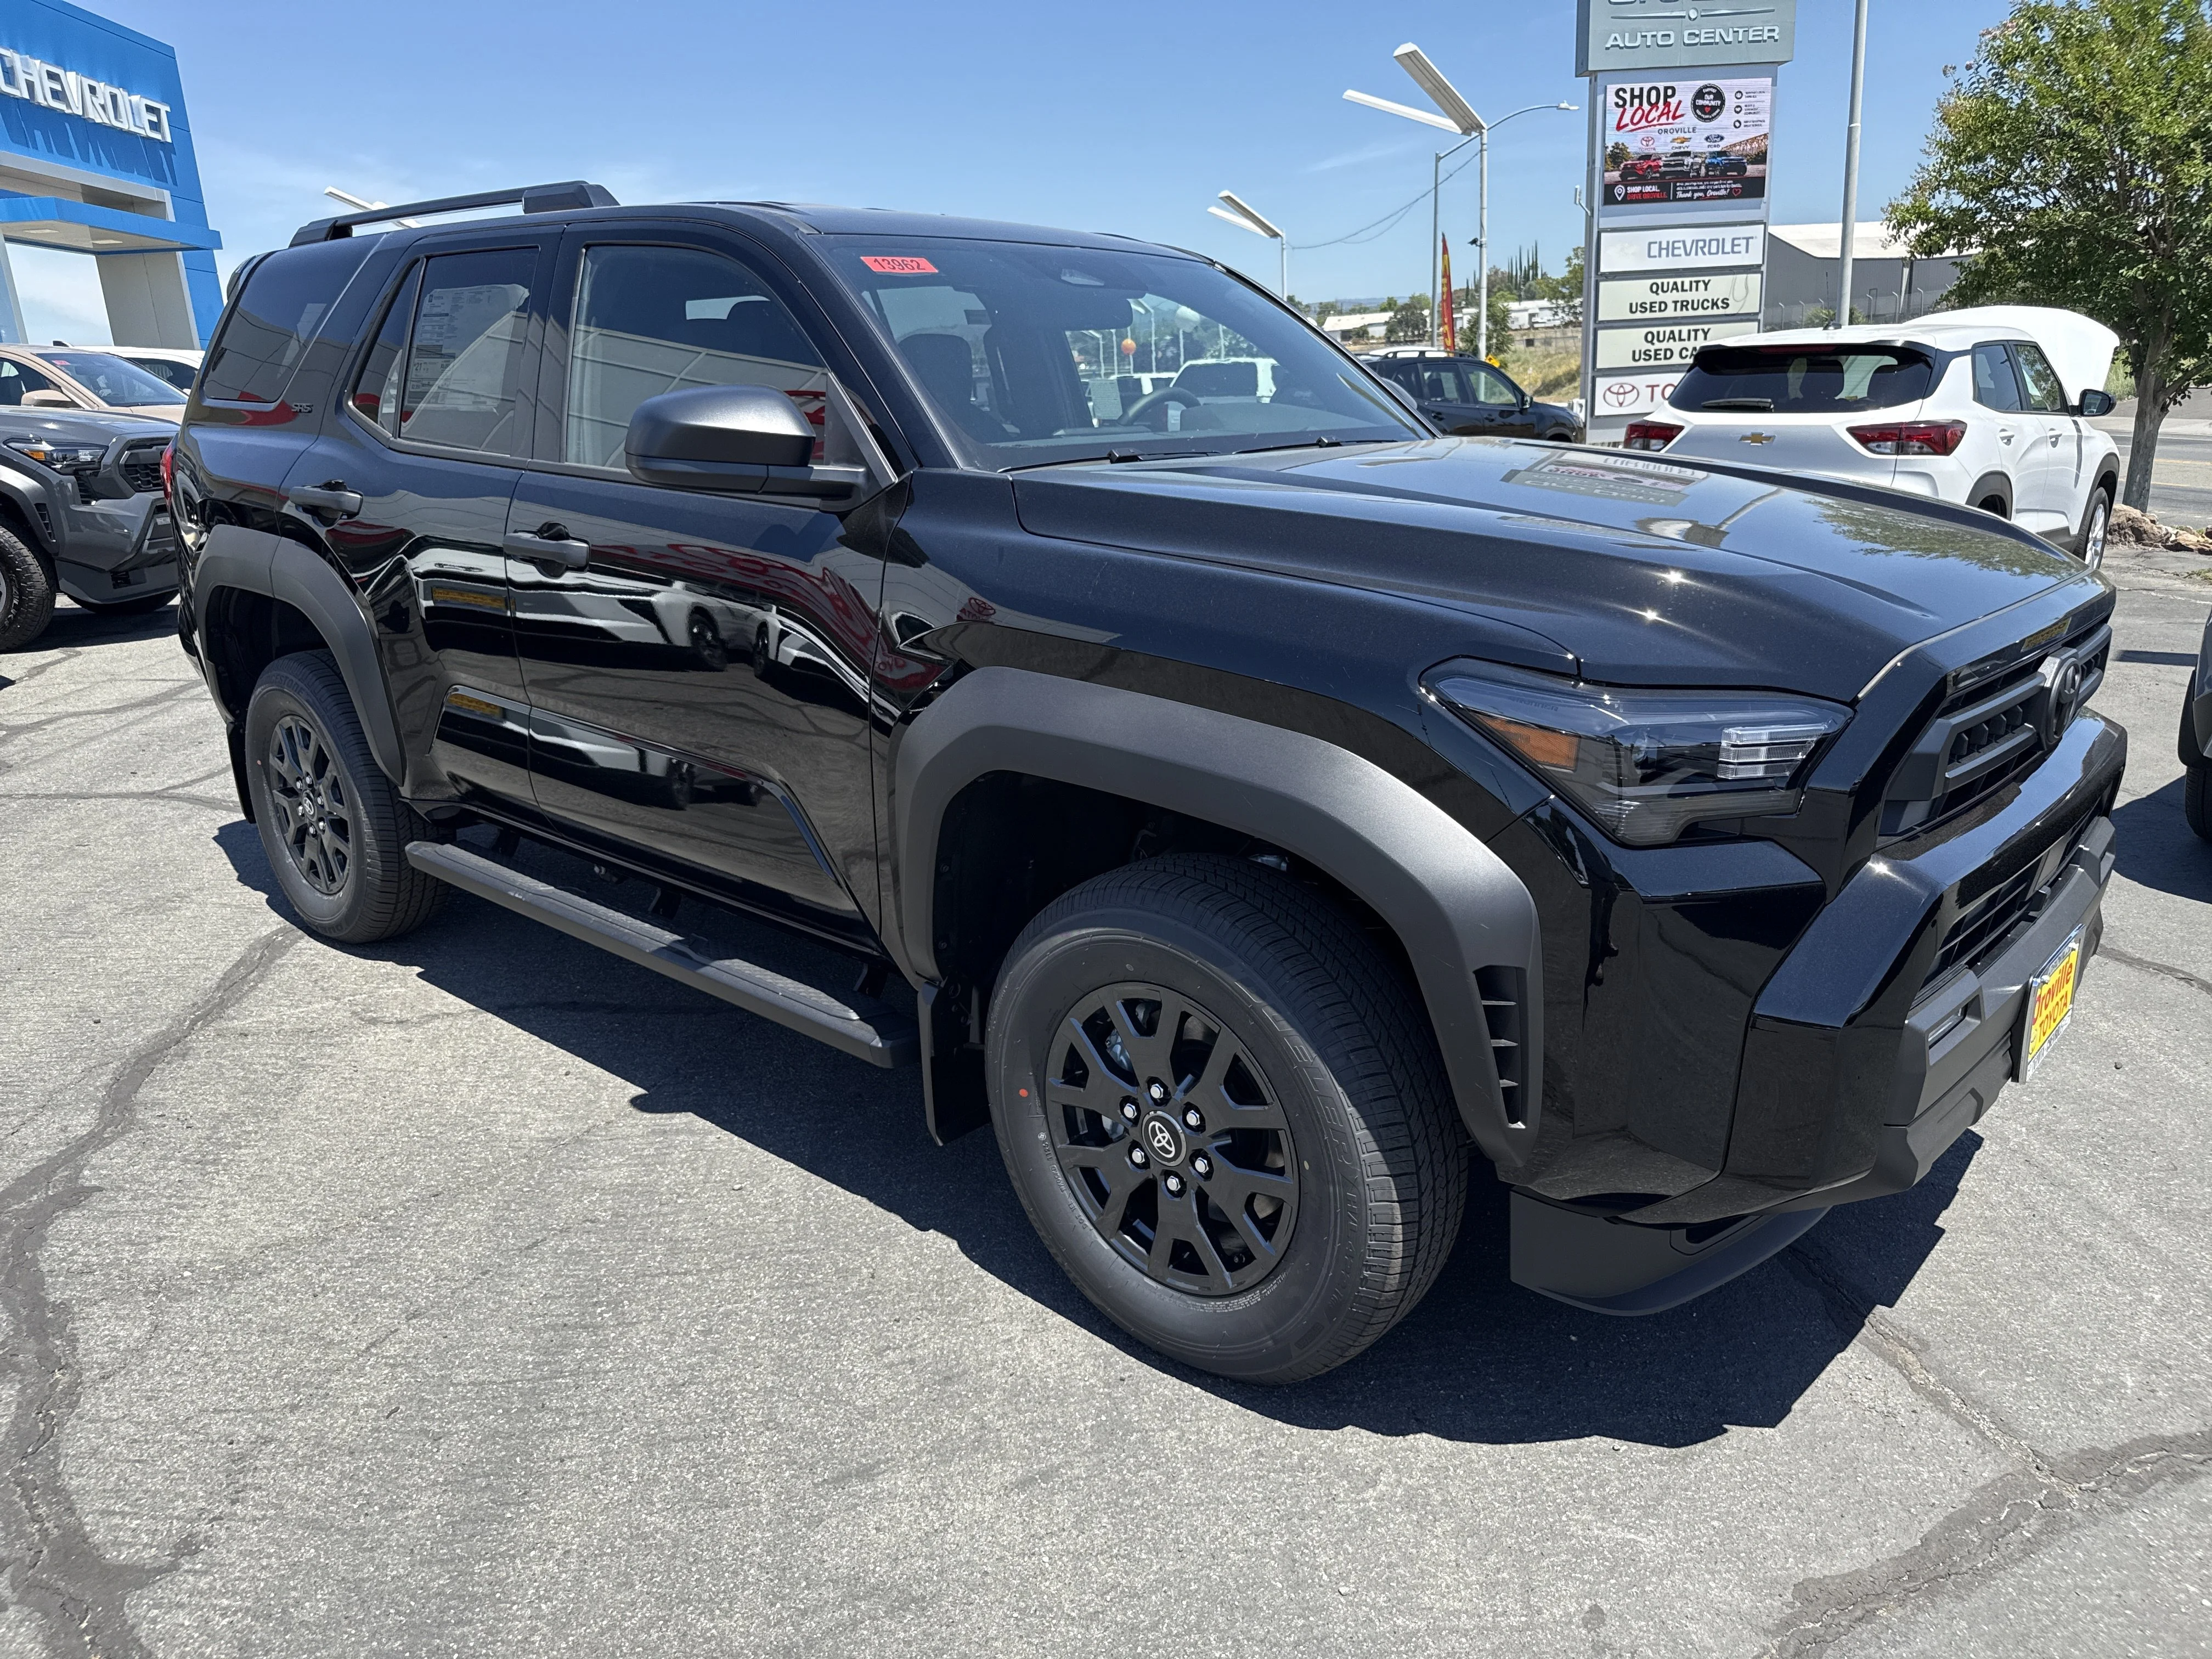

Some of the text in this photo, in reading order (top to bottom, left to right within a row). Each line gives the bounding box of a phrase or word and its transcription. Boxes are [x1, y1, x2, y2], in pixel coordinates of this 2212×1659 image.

[1605, 26, 1779, 49] AUTO CENTER
[0, 48, 172, 143] CHEVROLET
[1614, 86, 1676, 108] SHOP
[1616, 100, 1686, 131] LOCAL
[1647, 236, 1753, 259] CHEVROLET
[873, 258, 926, 271] 13962
[1649, 279, 1711, 295] QUALITY
[1629, 297, 1730, 314] USED TRUCKS
[1644, 328, 1711, 345] QUALITY
[1632, 346, 1698, 362] USED CA
[2032, 962, 2072, 1026] Oroville
[2039, 990, 2068, 1042] TOYOTA
